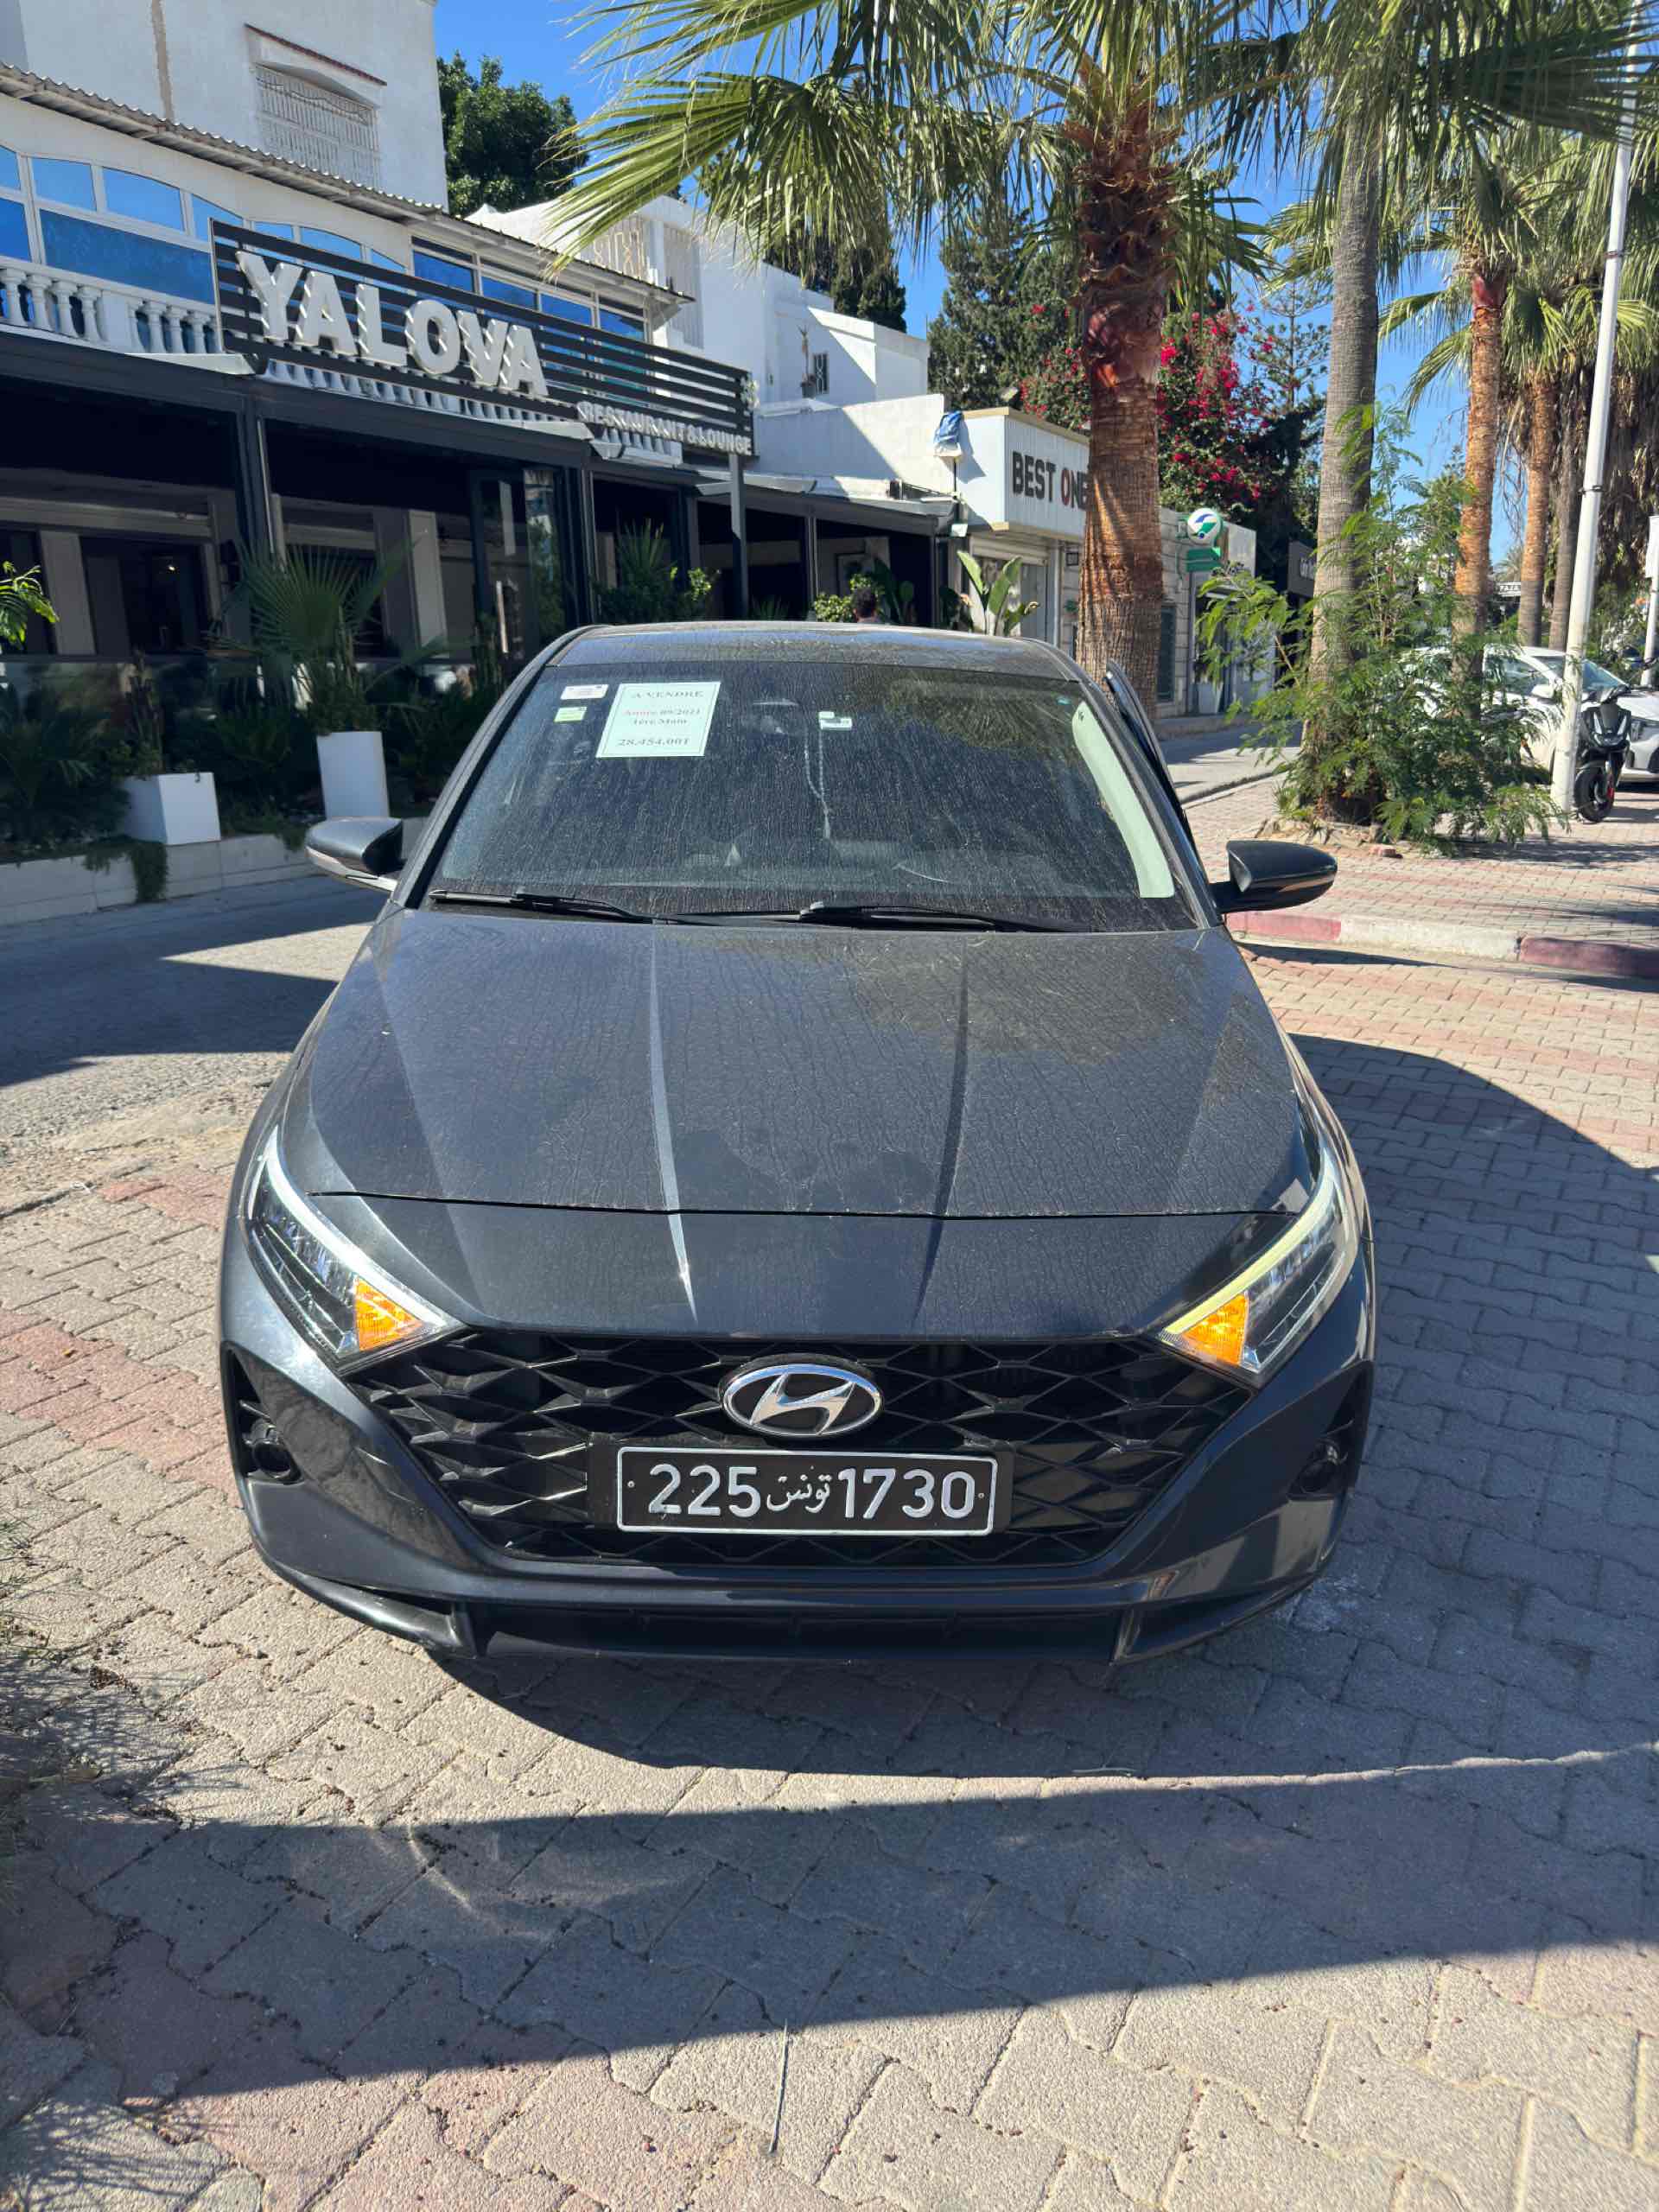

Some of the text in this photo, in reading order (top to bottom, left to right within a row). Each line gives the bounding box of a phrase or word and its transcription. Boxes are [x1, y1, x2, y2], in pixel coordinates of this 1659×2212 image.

[235, 251, 549, 397] YALOVA
[1013, 451, 1055, 502] BEST
[646, 690, 703, 699] VENDRE
[648, 1464, 976, 1519] 225 تونس 1730
